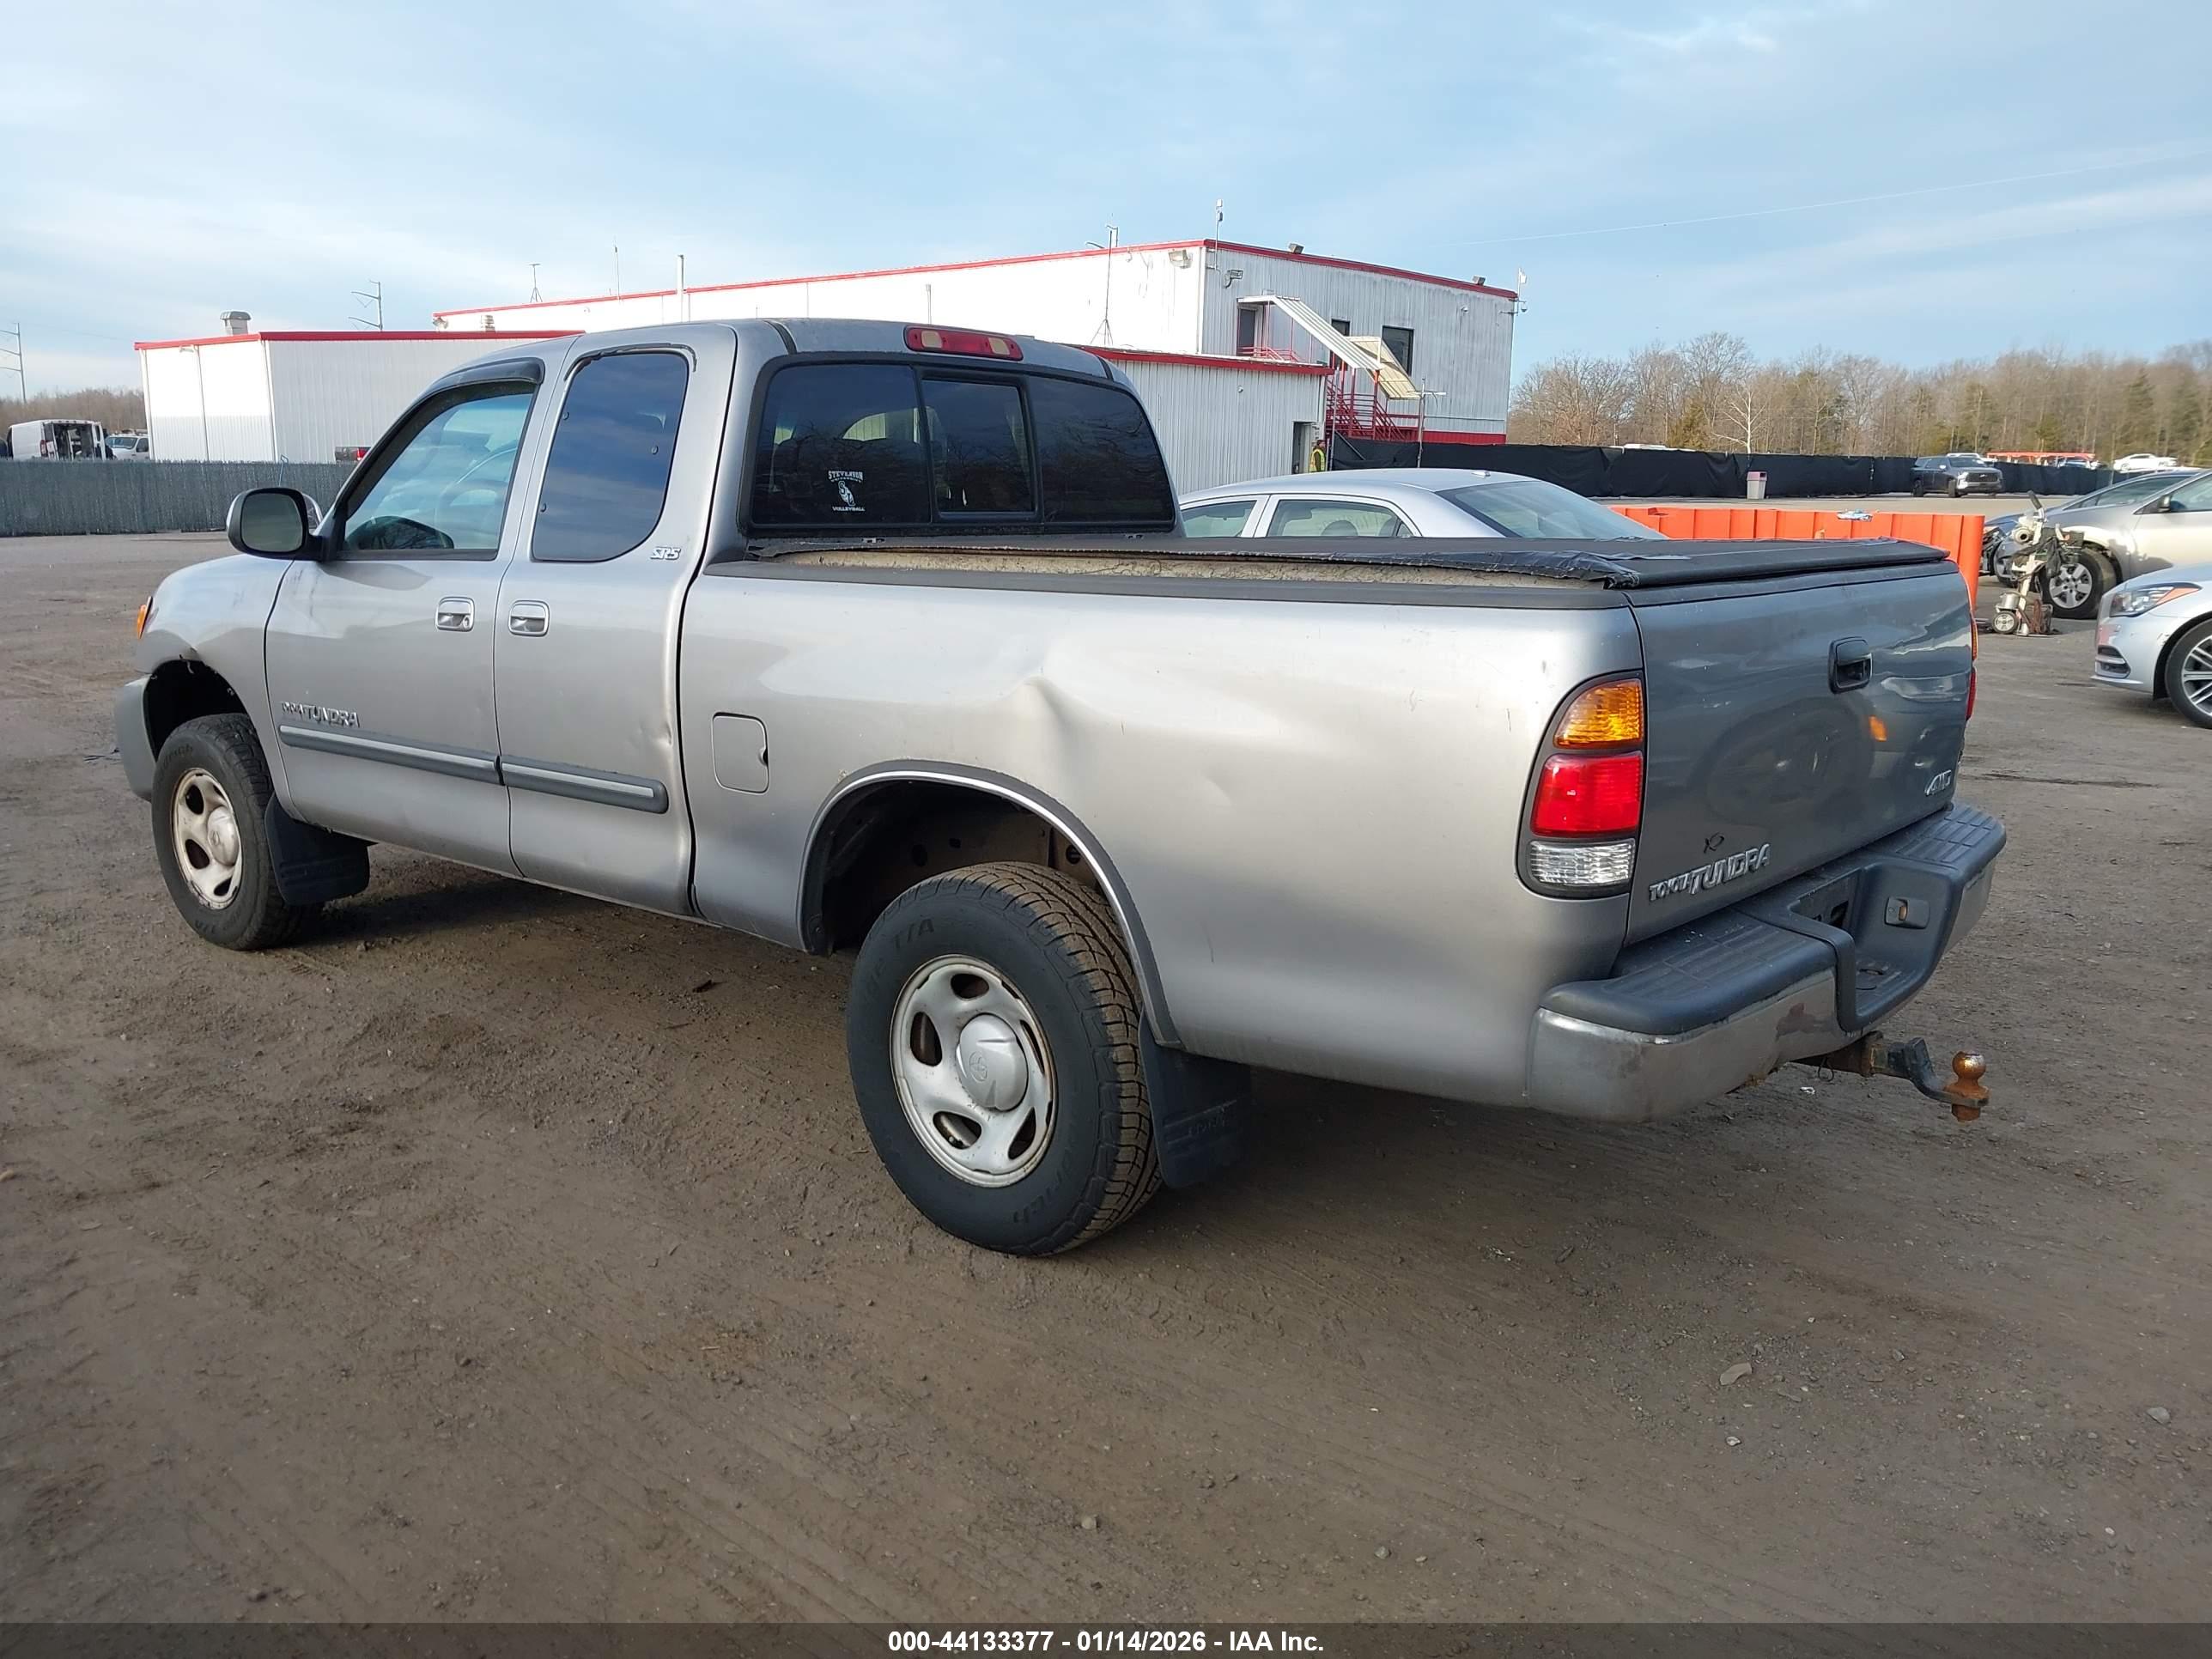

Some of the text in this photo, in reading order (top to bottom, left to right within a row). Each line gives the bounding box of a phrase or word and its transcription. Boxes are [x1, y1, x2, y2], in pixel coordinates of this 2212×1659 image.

[828, 471, 863, 481] STEVENSON
[650, 546, 681, 560] SR5
[302, 704, 360, 728] TUNDRA
[1688, 843, 1771, 895] TUNDRA
